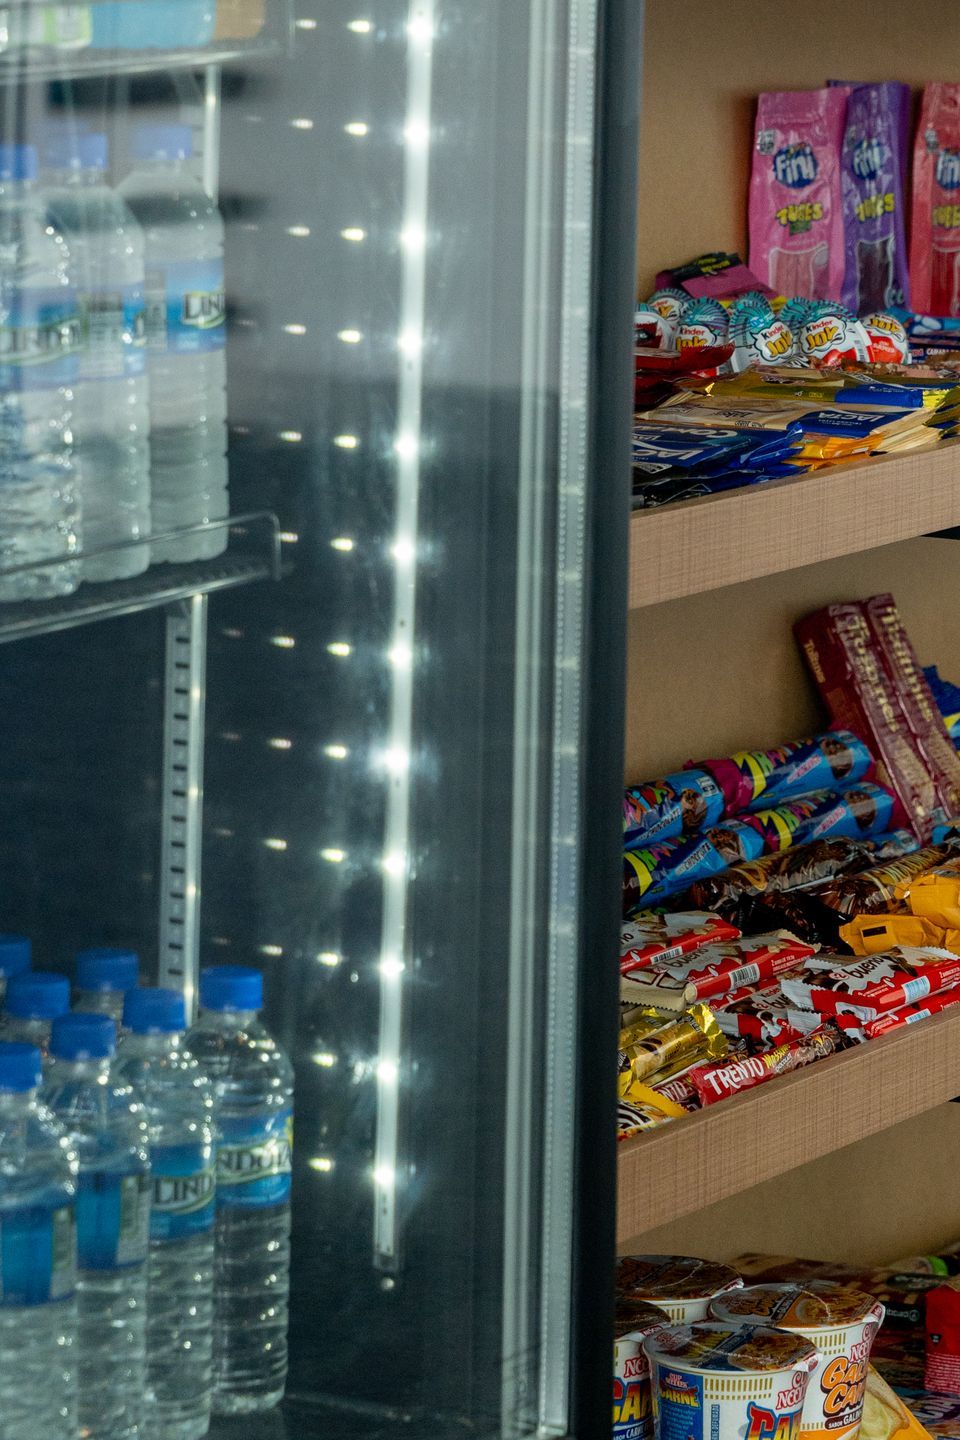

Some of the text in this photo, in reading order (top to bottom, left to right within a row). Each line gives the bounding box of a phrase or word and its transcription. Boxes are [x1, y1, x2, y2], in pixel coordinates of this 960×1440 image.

[776, 147, 815, 183] Fini
[660, 1081, 687, 1102] NTO
[704, 1057, 765, 1095] TRENTO
